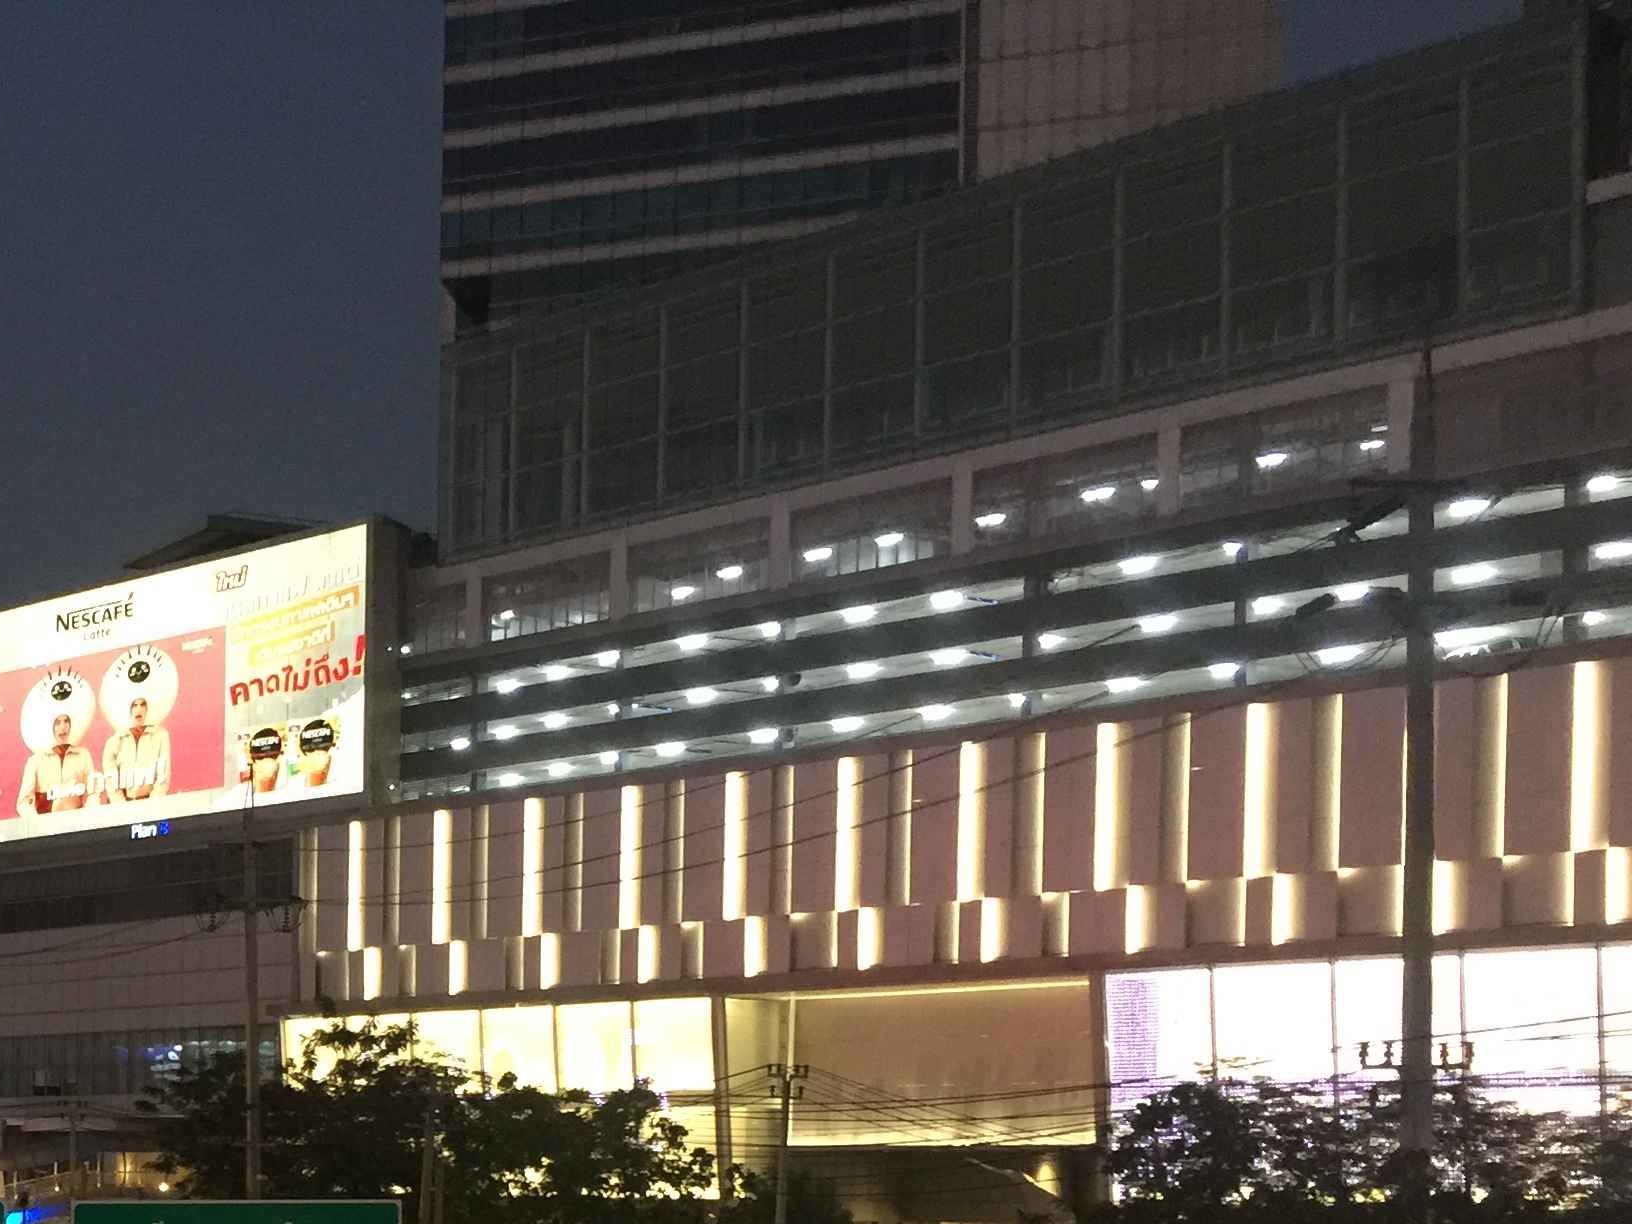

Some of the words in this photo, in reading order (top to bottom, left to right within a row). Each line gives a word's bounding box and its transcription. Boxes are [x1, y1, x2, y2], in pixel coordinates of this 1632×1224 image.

[55, 592, 135, 632] NESCAFÉ
[83, 628, 111, 641] Latte
[131, 823, 157, 839] Plan
